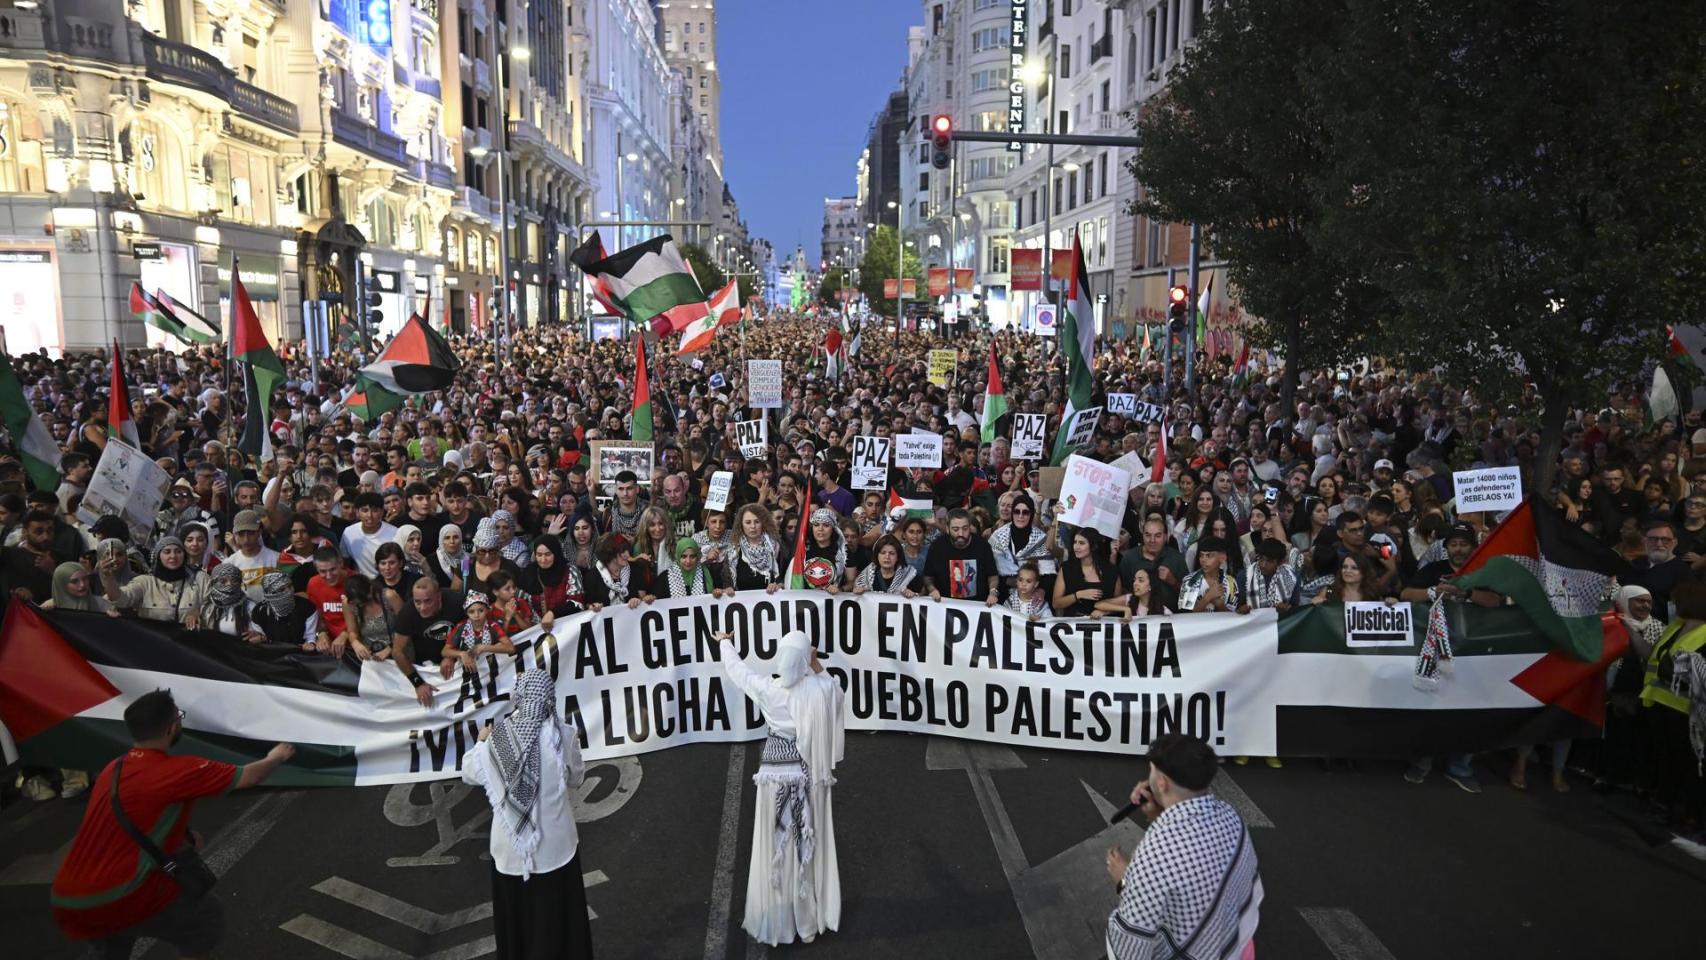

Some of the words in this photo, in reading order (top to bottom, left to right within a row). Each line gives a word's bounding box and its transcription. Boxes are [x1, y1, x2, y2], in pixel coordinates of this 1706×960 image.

[1010, 53, 1024, 149] REGENTE
[751, 361, 780, 369] EUROPA
[1109, 395, 1134, 411] PAZ
[1134, 402, 1163, 421] PAZ
[1078, 409, 1100, 423] PAZ
[737, 420, 763, 446] PAZ
[1013, 414, 1045, 440] PAZ
[853, 437, 889, 468] PAZ
[898, 452, 909, 460] toda
[910, 452, 932, 460] Palestina
[922, 443, 936, 451] exige
[1073, 460, 1112, 487] STOP
[1457, 477, 1475, 485] Matar
[1477, 474, 1496, 482] 14000
[1497, 473, 1517, 481] niños
[1461, 487, 1472, 495] ¿es
[1473, 482, 1515, 493] defenderse?
[1462, 492, 1502, 504] ¡REBELAOS
[1503, 492, 1515, 500] YA!
[1346, 606, 1410, 633] ¡Justicia!
[574, 617, 628, 679] AL
[639, 597, 862, 668] GENOCIDIO
[877, 602, 928, 663] EN
[943, 608, 1182, 678] PALESTINA
[601, 675, 732, 746] LUCHA
[984, 682, 1227, 746] PALESTINO!
